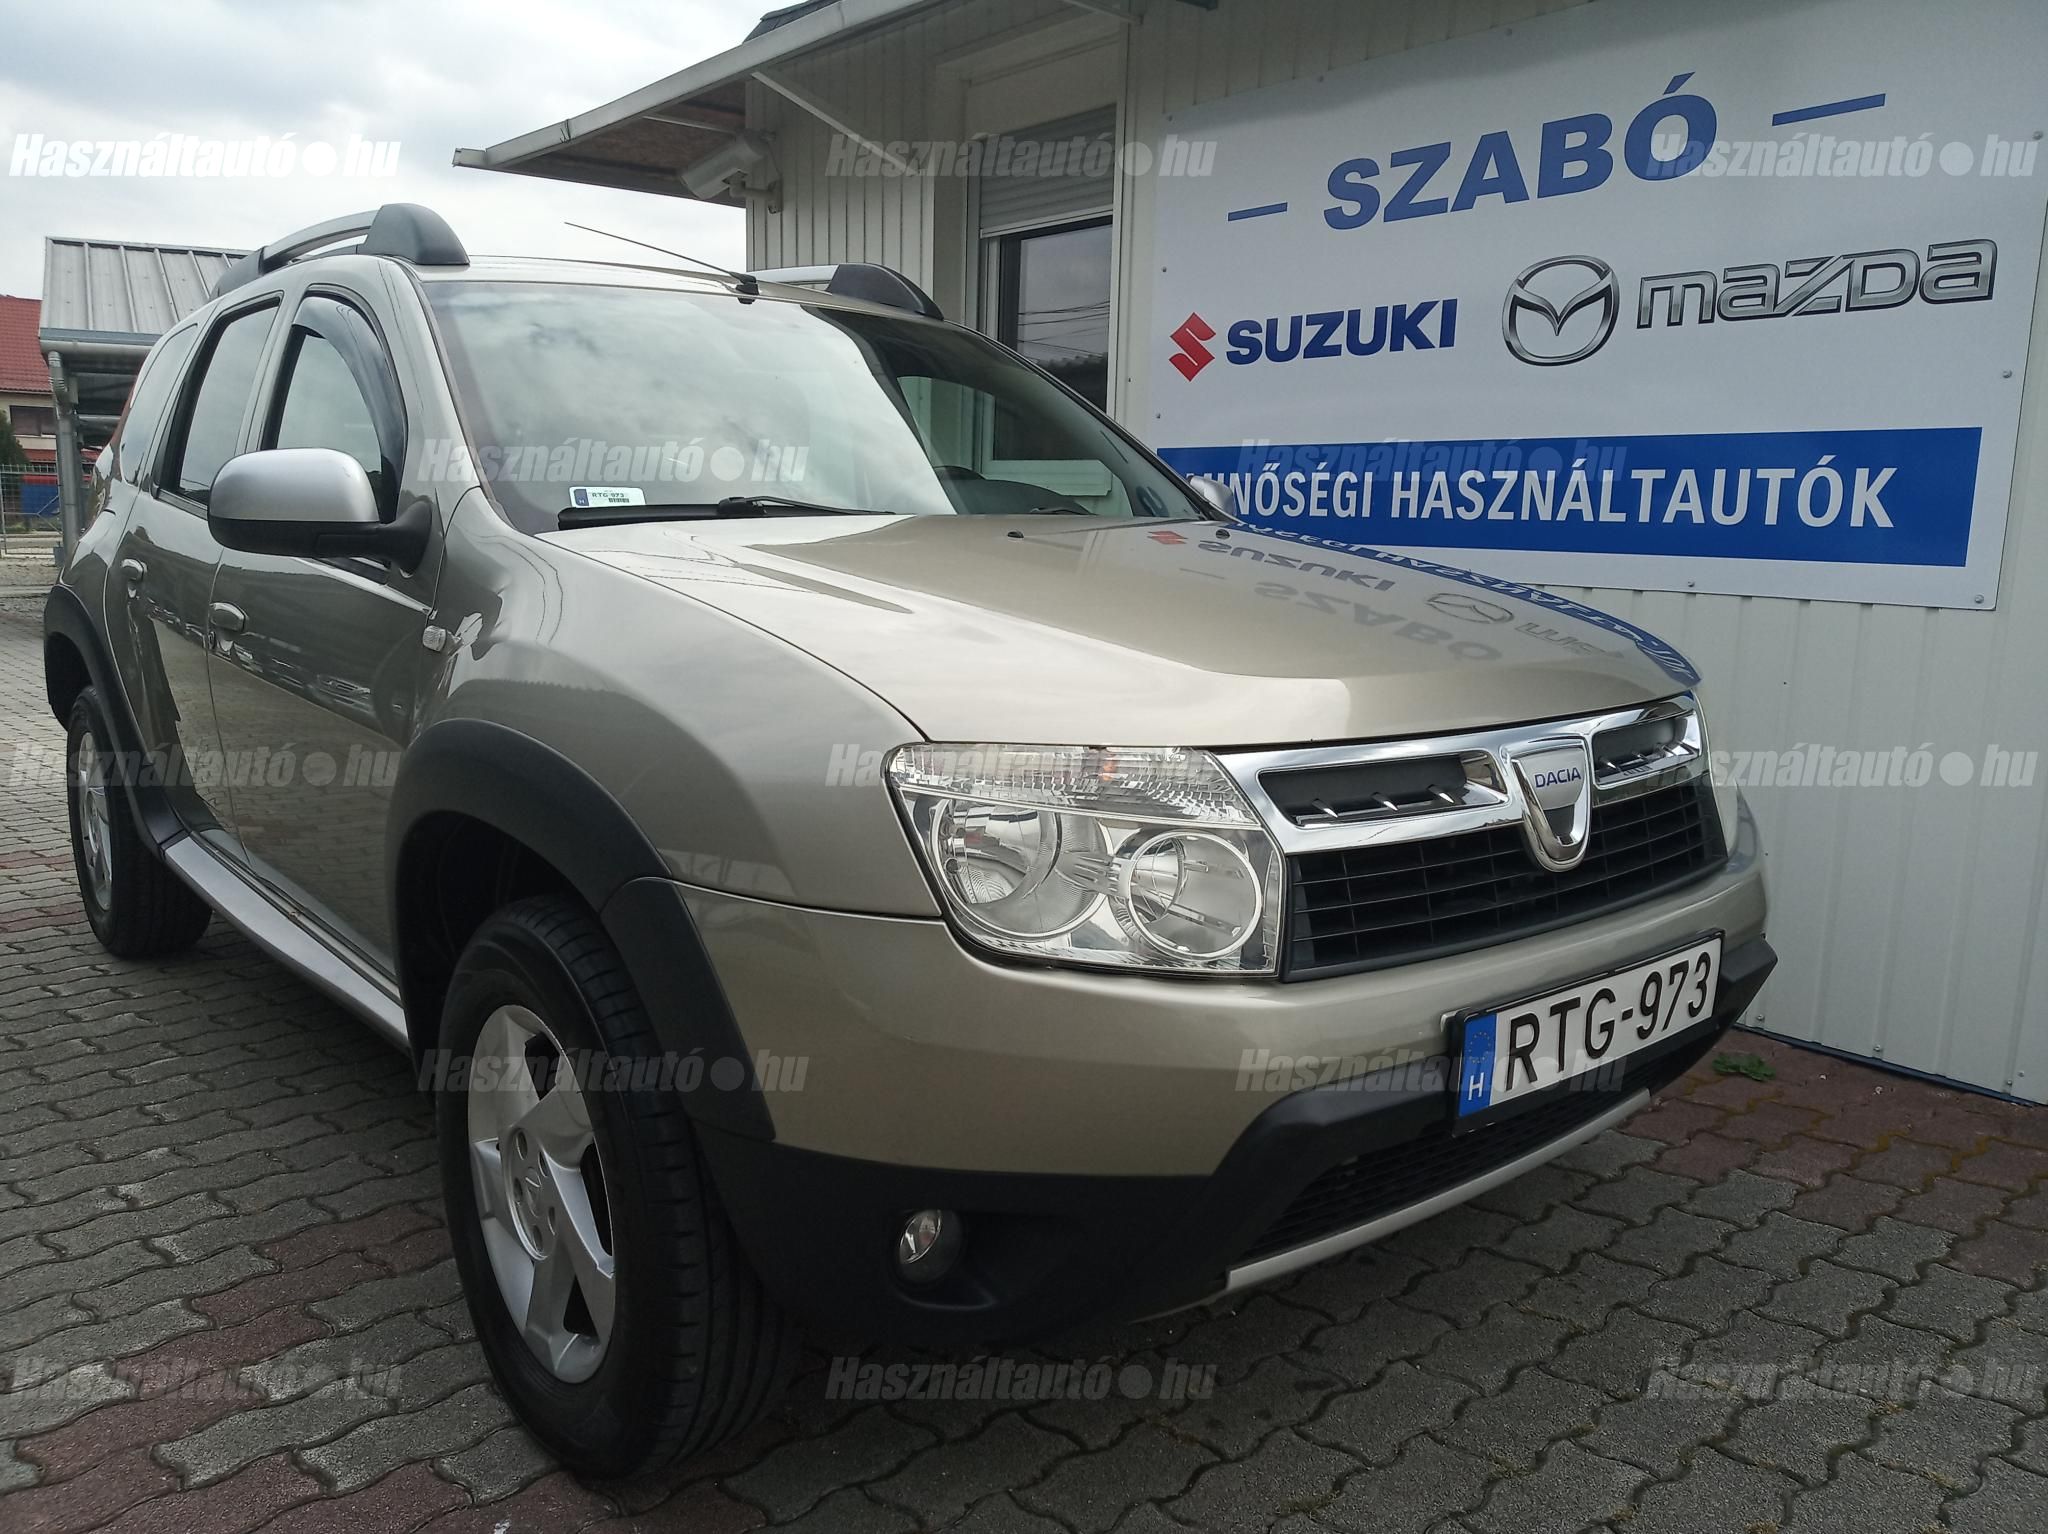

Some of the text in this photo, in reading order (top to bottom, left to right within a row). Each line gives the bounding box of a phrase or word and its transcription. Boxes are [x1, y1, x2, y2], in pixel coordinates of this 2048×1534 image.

[1323, 72, 1717, 230] SZABÓ
[1225, 299, 1458, 366] SUZUKI
[1186, 455, 1898, 528] NŐSÉGI HASZNÁLTAUTÓK
[1534, 767, 1581, 788] DACIA
[1505, 951, 1712, 1092] RTG-973
[1468, 1072, 1485, 1101] H
